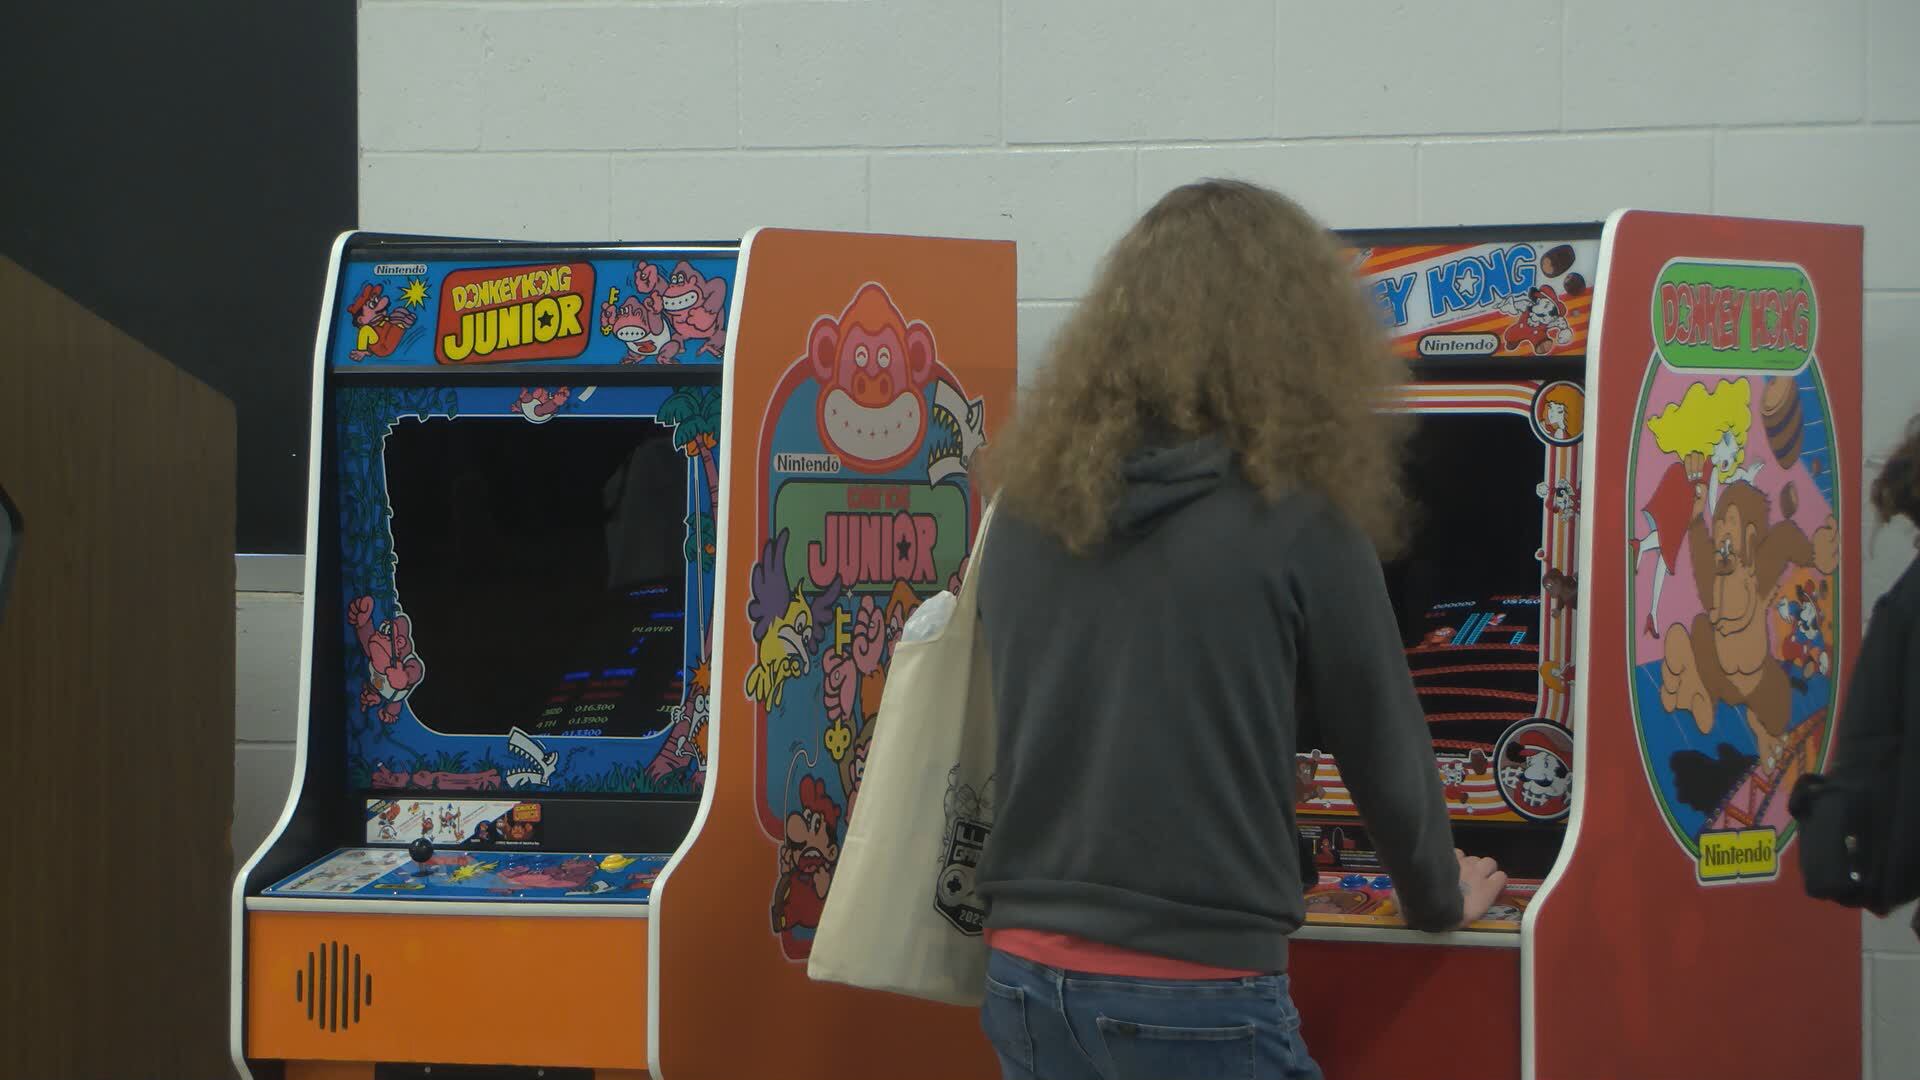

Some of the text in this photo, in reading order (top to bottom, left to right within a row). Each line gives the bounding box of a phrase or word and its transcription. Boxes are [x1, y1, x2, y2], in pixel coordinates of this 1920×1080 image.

[375, 264, 426, 275] Nintendo
[1426, 243, 1537, 318] KONG
[452, 266, 572, 311] DONKEY KONG
[443, 295, 584, 360] JUNIOR
[1424, 339, 1494, 352] Nintendo
[776, 455, 840, 472] Nintendo
[808, 509, 938, 589] JUNIOR
[631, 625, 674, 633] PLAYER
[1704, 840, 1773, 866] Nintendo
